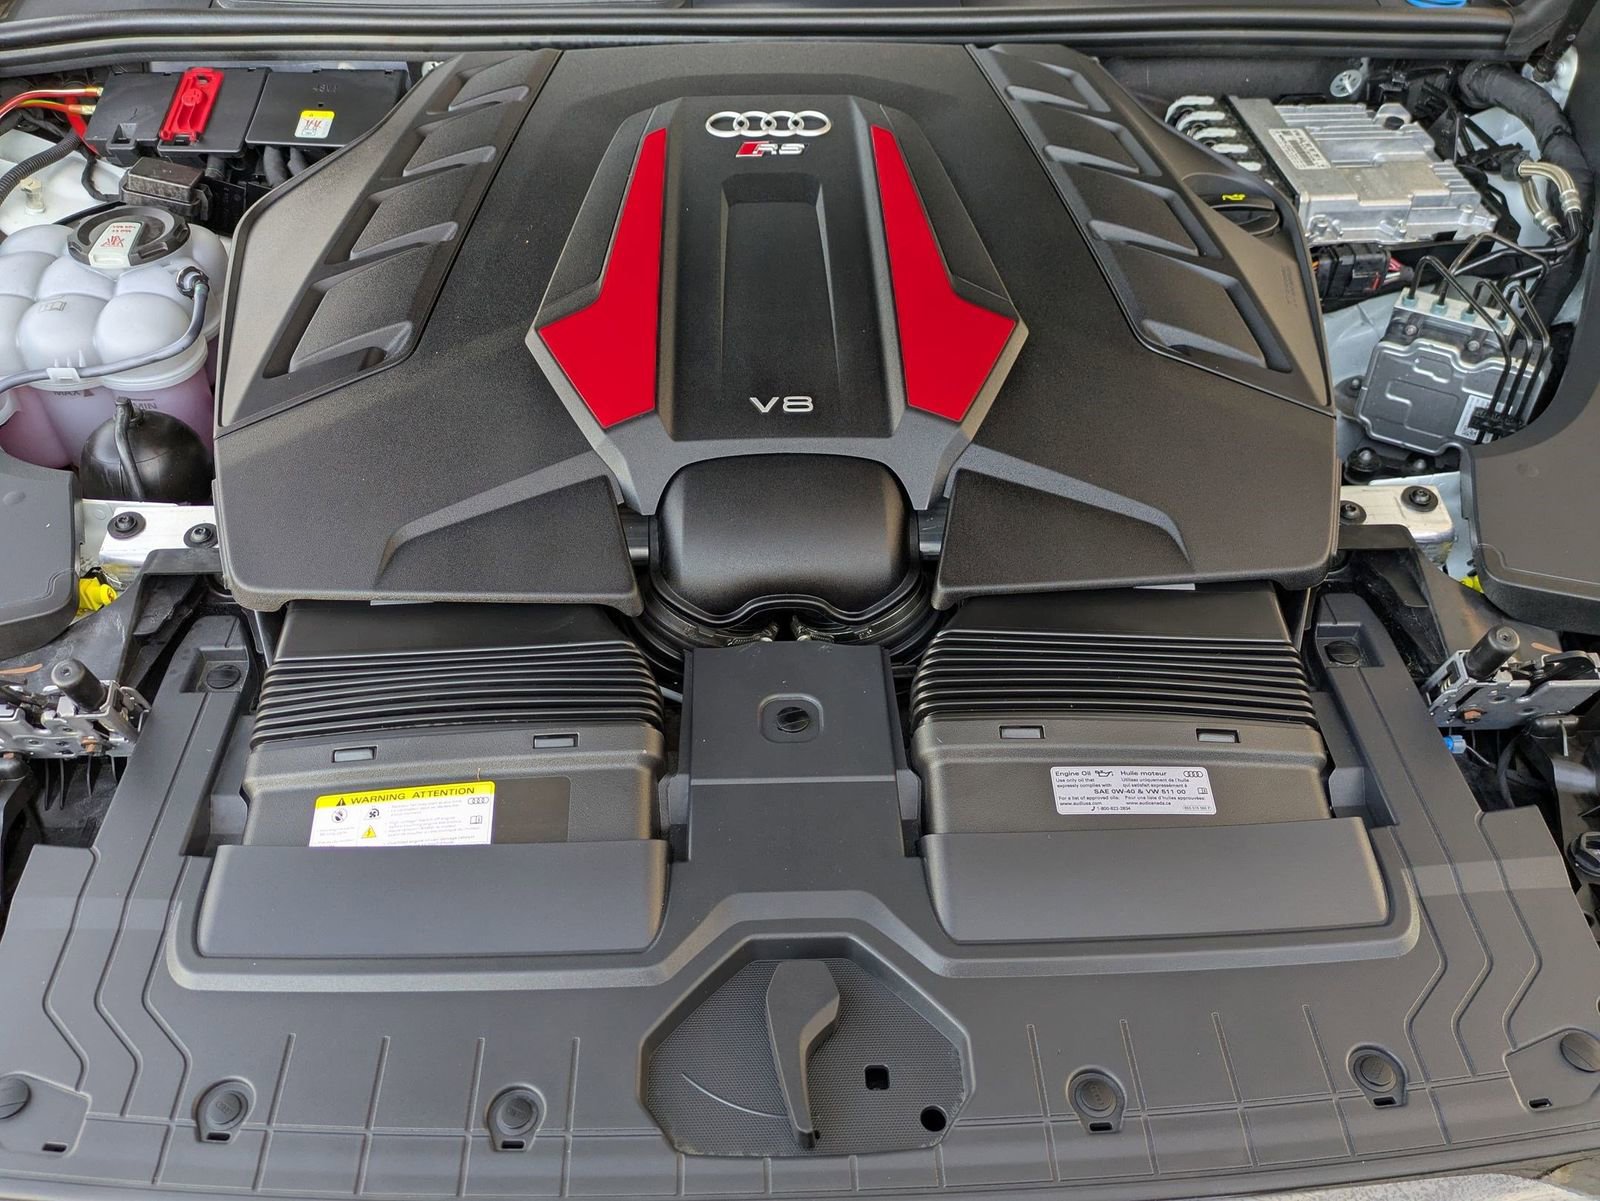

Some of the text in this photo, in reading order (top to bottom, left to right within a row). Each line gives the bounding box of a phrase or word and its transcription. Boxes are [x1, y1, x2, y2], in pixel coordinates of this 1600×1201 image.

[744, 141, 806, 156] RS
[749, 396, 814, 413] V8
[350, 786, 475, 805] WARNING ATTENTION
